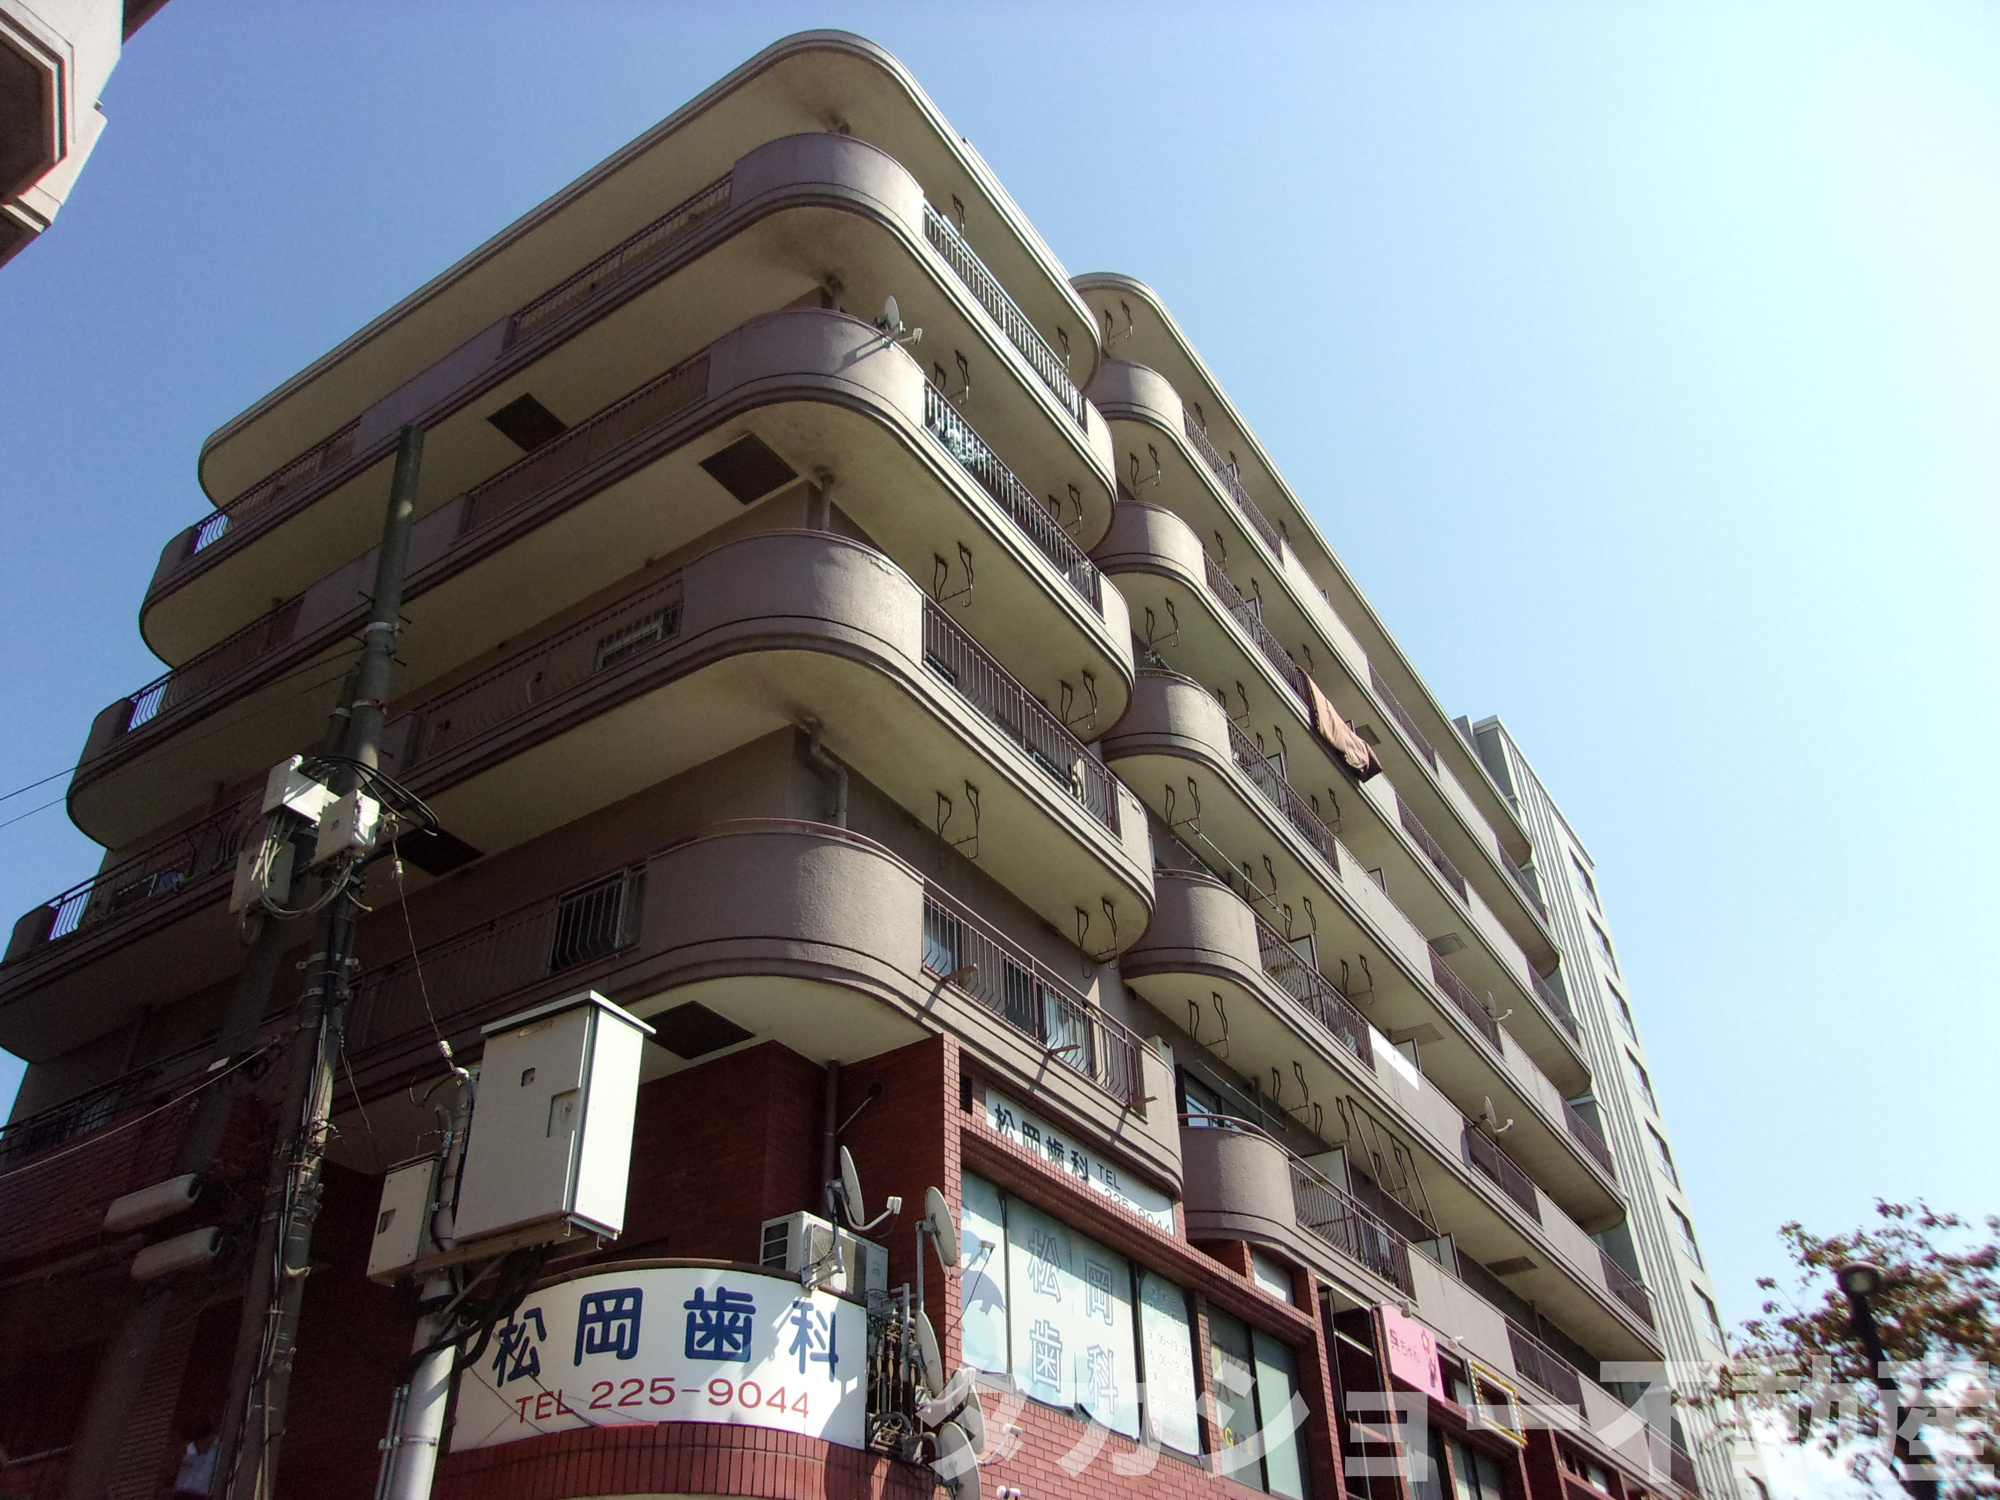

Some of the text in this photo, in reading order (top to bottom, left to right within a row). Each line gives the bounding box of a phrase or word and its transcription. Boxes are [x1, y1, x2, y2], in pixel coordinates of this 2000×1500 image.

[994, 1103, 1122, 1191] 松岡歯科 TEL
[1028, 1230, 1114, 1327] 松岡
[491, 1286, 839, 1388] 松岡歯科
[1030, 1318, 1119, 1415] 歯科
[515, 1377, 810, 1424] TEL 225-9044
